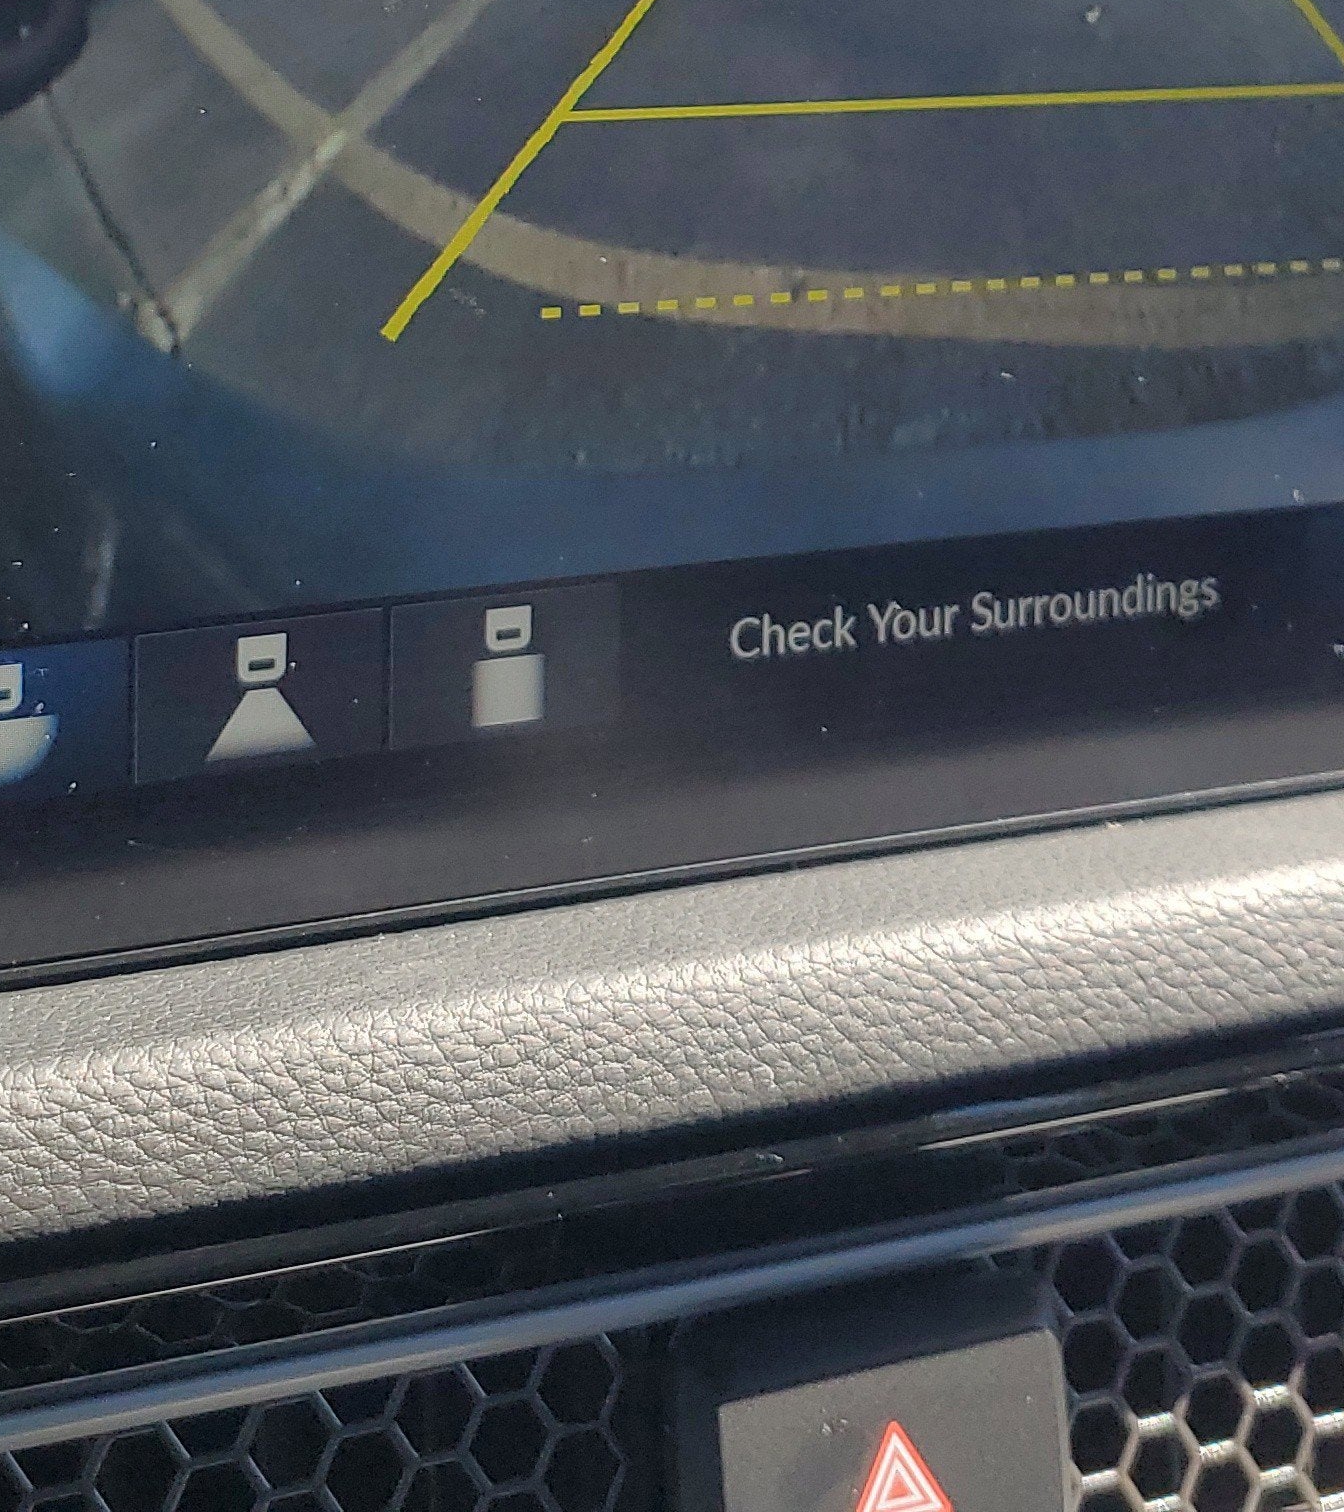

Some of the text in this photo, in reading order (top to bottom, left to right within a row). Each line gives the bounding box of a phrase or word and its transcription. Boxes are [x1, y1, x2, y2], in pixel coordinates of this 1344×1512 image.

[729, 571, 1221, 660] Check Your Surroundings
